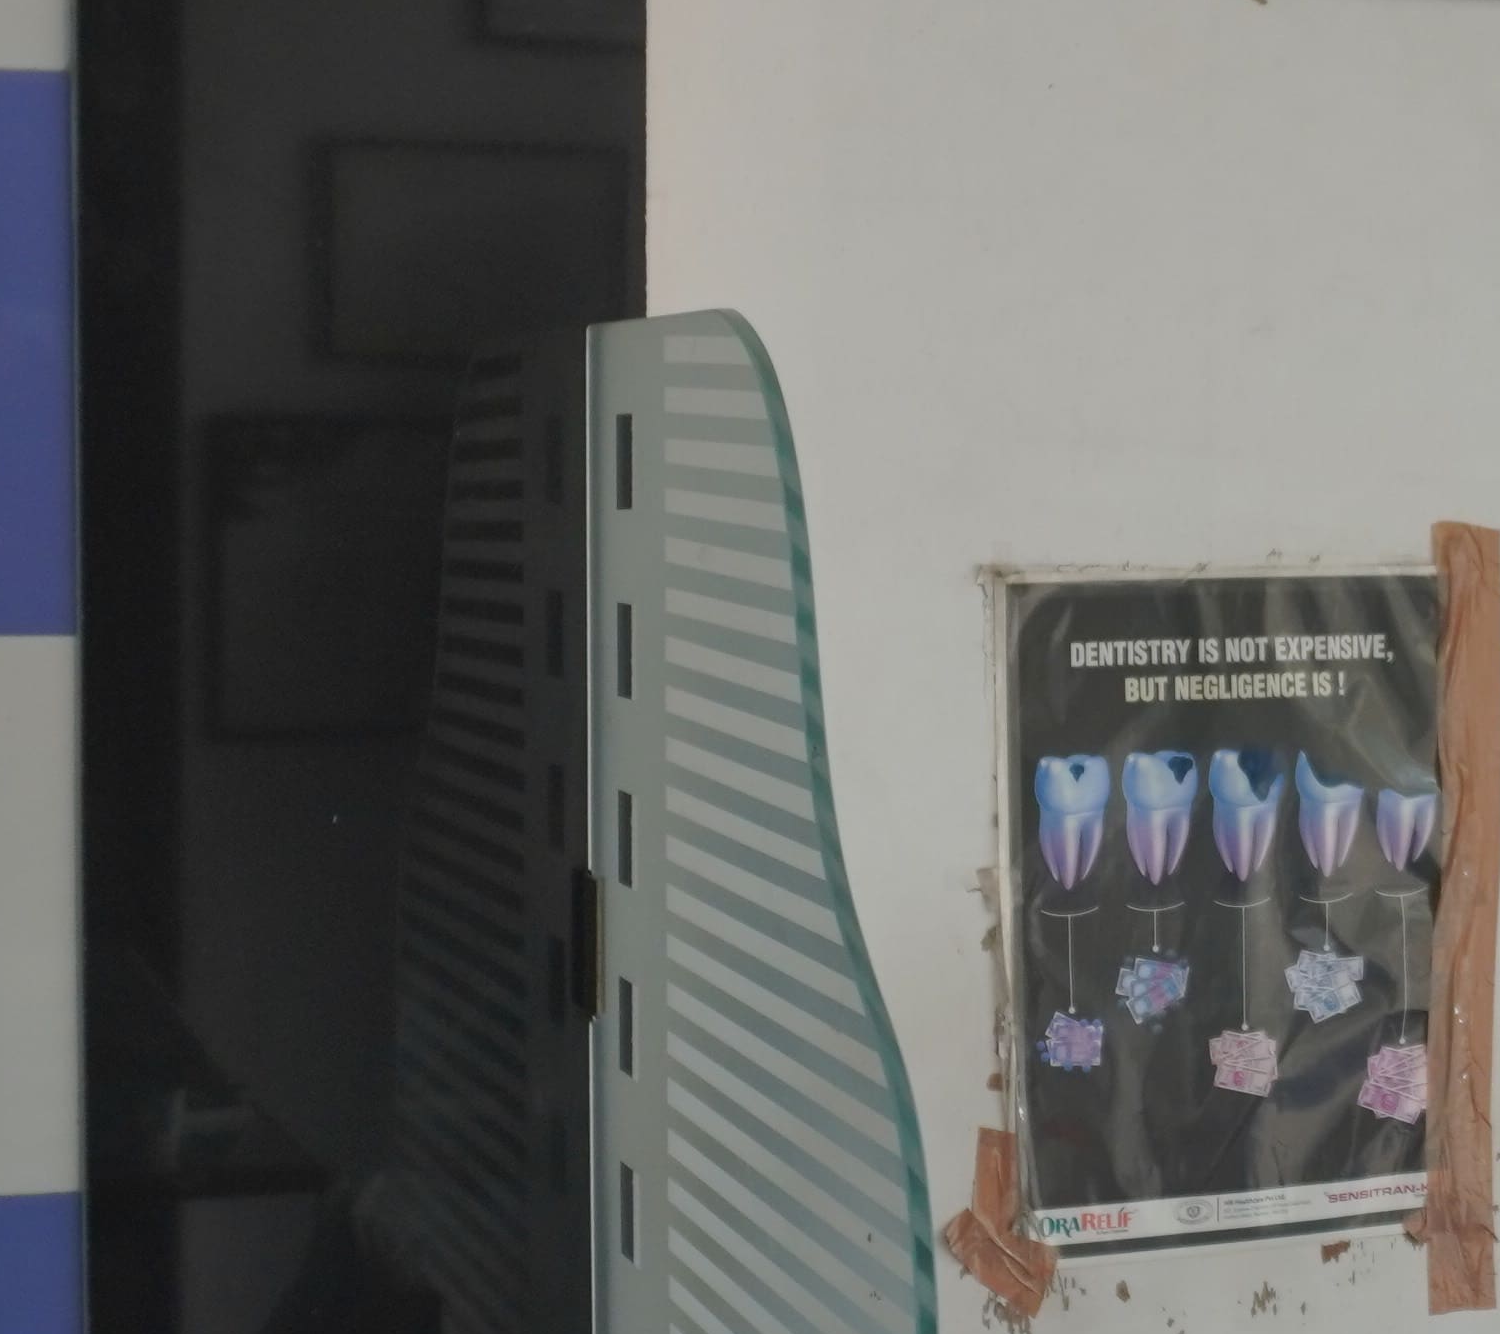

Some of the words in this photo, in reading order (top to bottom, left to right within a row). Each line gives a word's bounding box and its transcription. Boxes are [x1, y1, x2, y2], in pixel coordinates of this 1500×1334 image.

[1070, 639, 1190, 667] DENTISTRY
[1198, 638, 1219, 663] IS
[1225, 637, 1268, 663] NOT
[1274, 634, 1395, 663] EXPENSIVE,
[1124, 676, 1168, 702] BUT
[1174, 672, 1307, 701] NEGLIGENCE
[1312, 671, 1331, 696] IS
[1338, 671, 1345, 696] !
